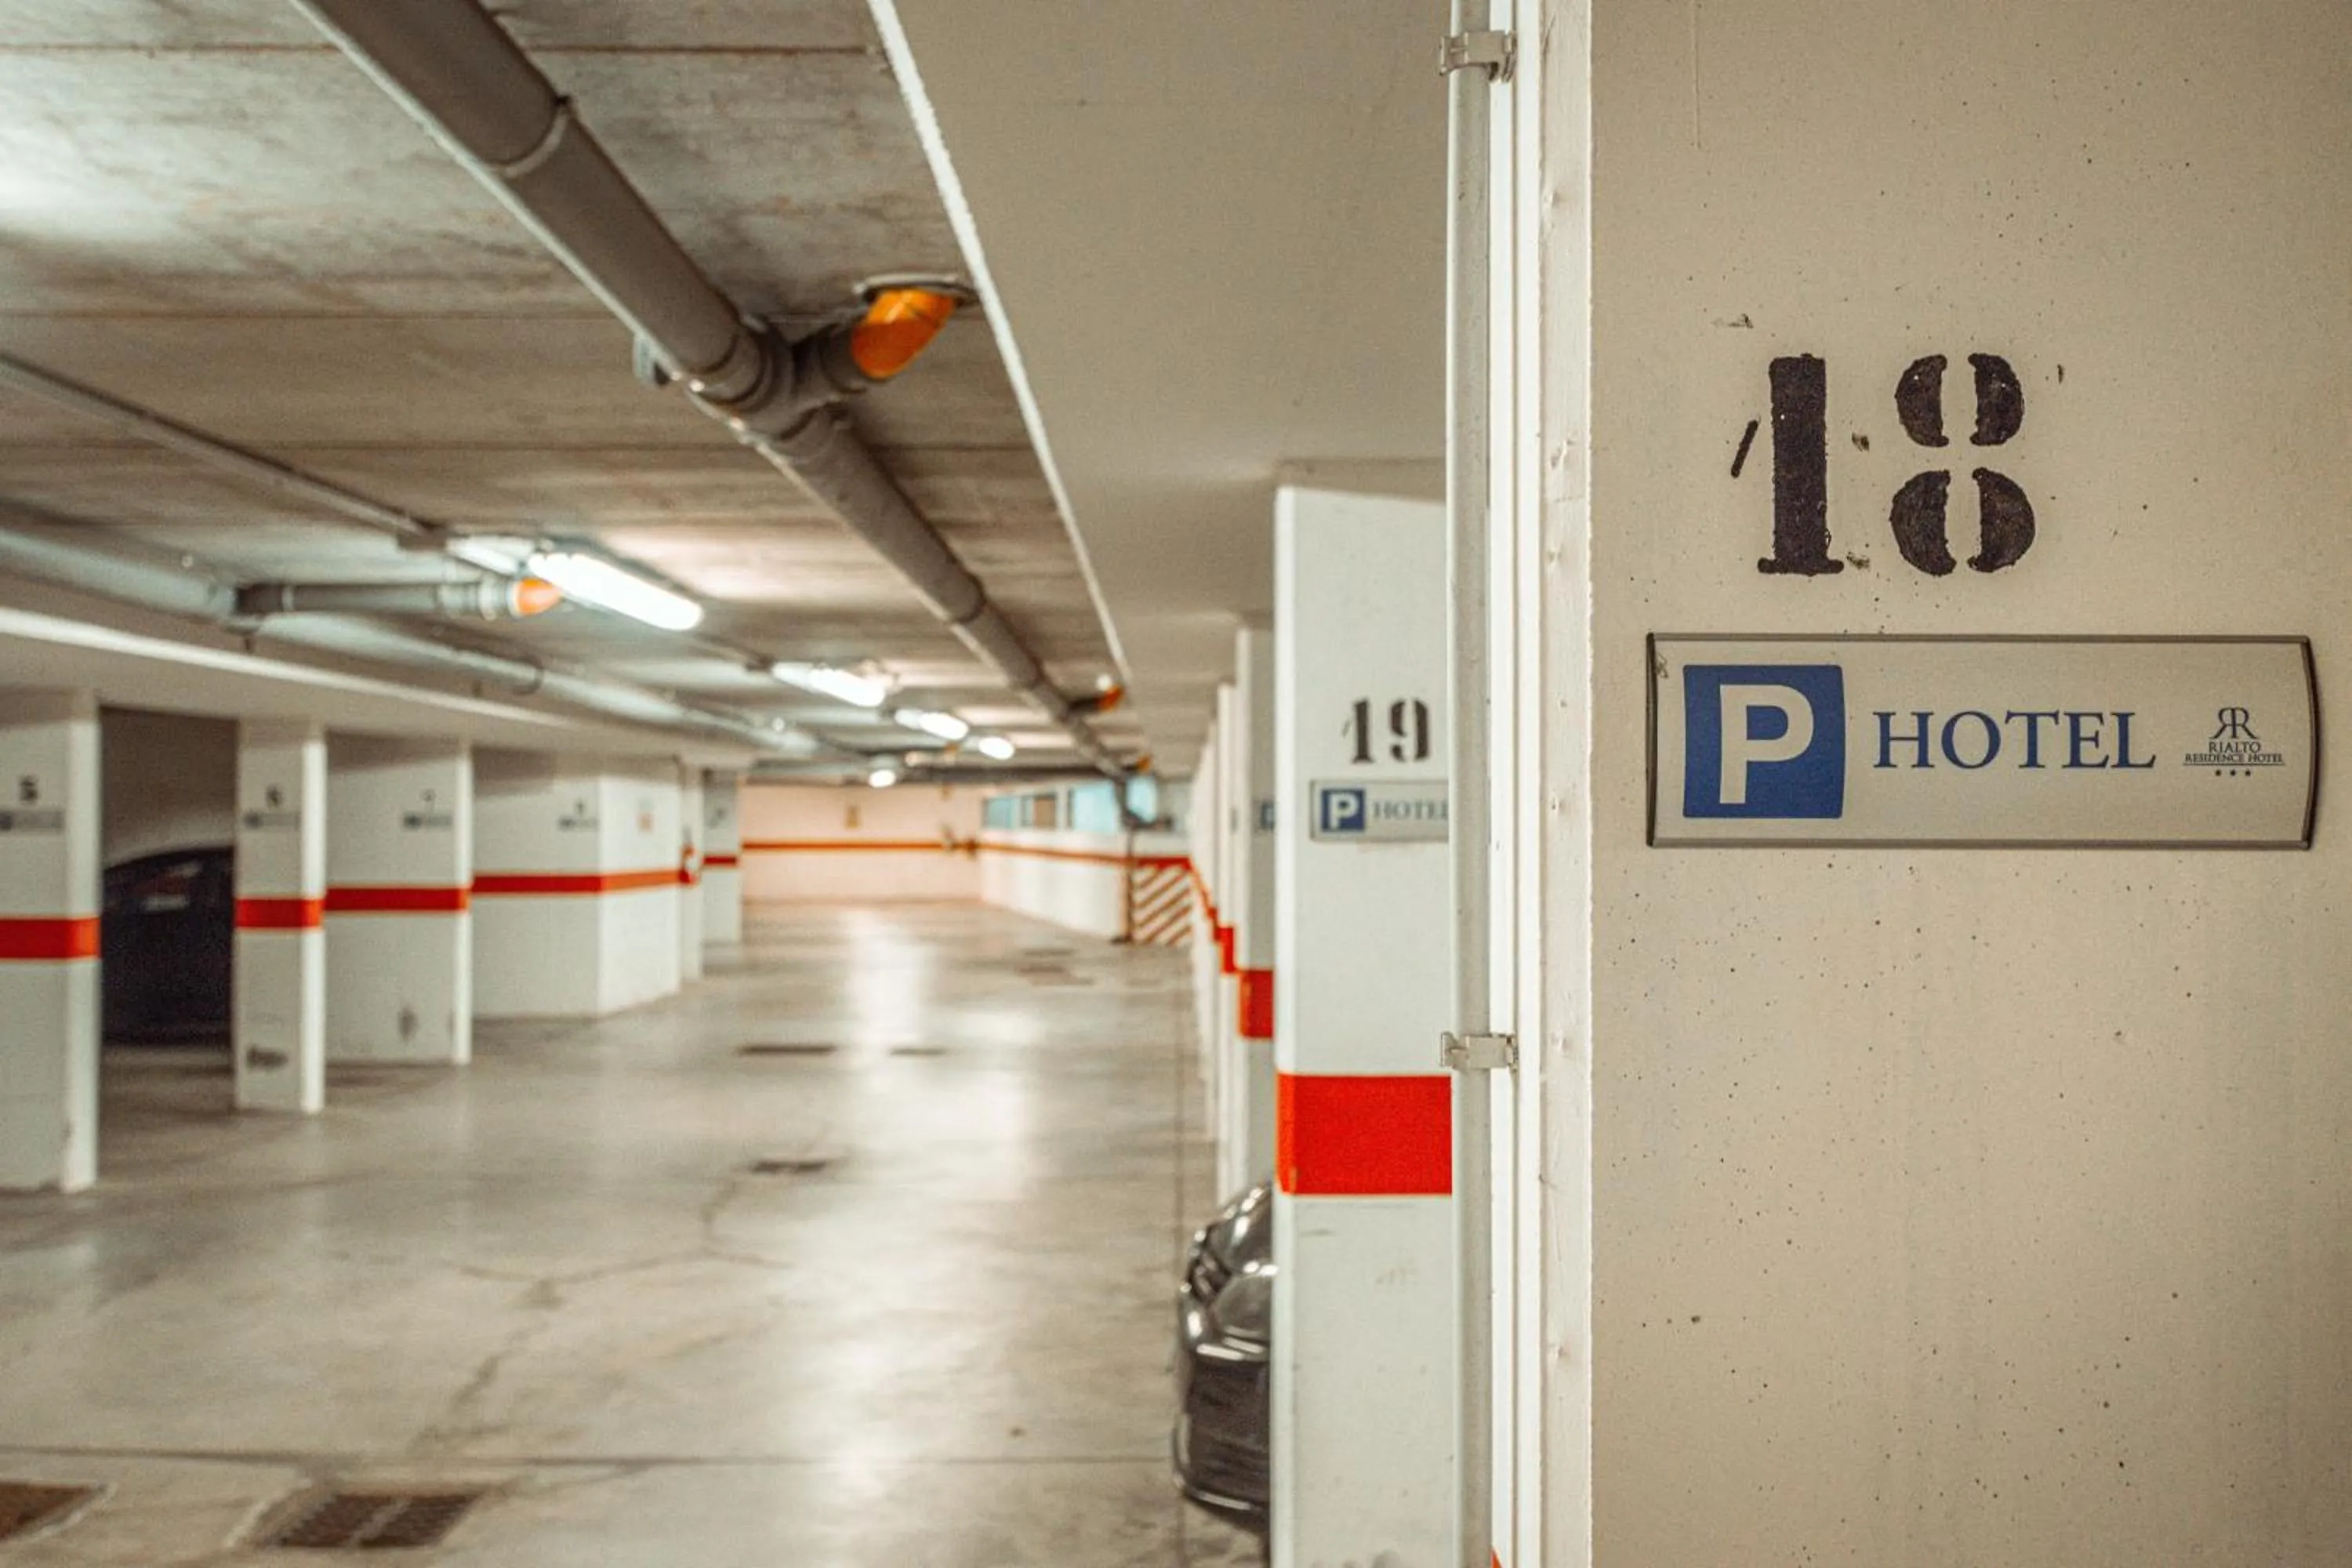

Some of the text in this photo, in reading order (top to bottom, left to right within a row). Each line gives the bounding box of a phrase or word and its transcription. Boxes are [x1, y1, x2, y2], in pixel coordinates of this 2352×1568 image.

[1731, 353, 2035, 575] 18
[1341, 699, 1428, 764] 19
[1719, 684, 2157, 804] P HOTEL
[2209, 741, 2262, 753] RIALTO
[2185, 753, 2283, 763] RESIDENCE HOTEL
[1330, 793, 1359, 829] P
